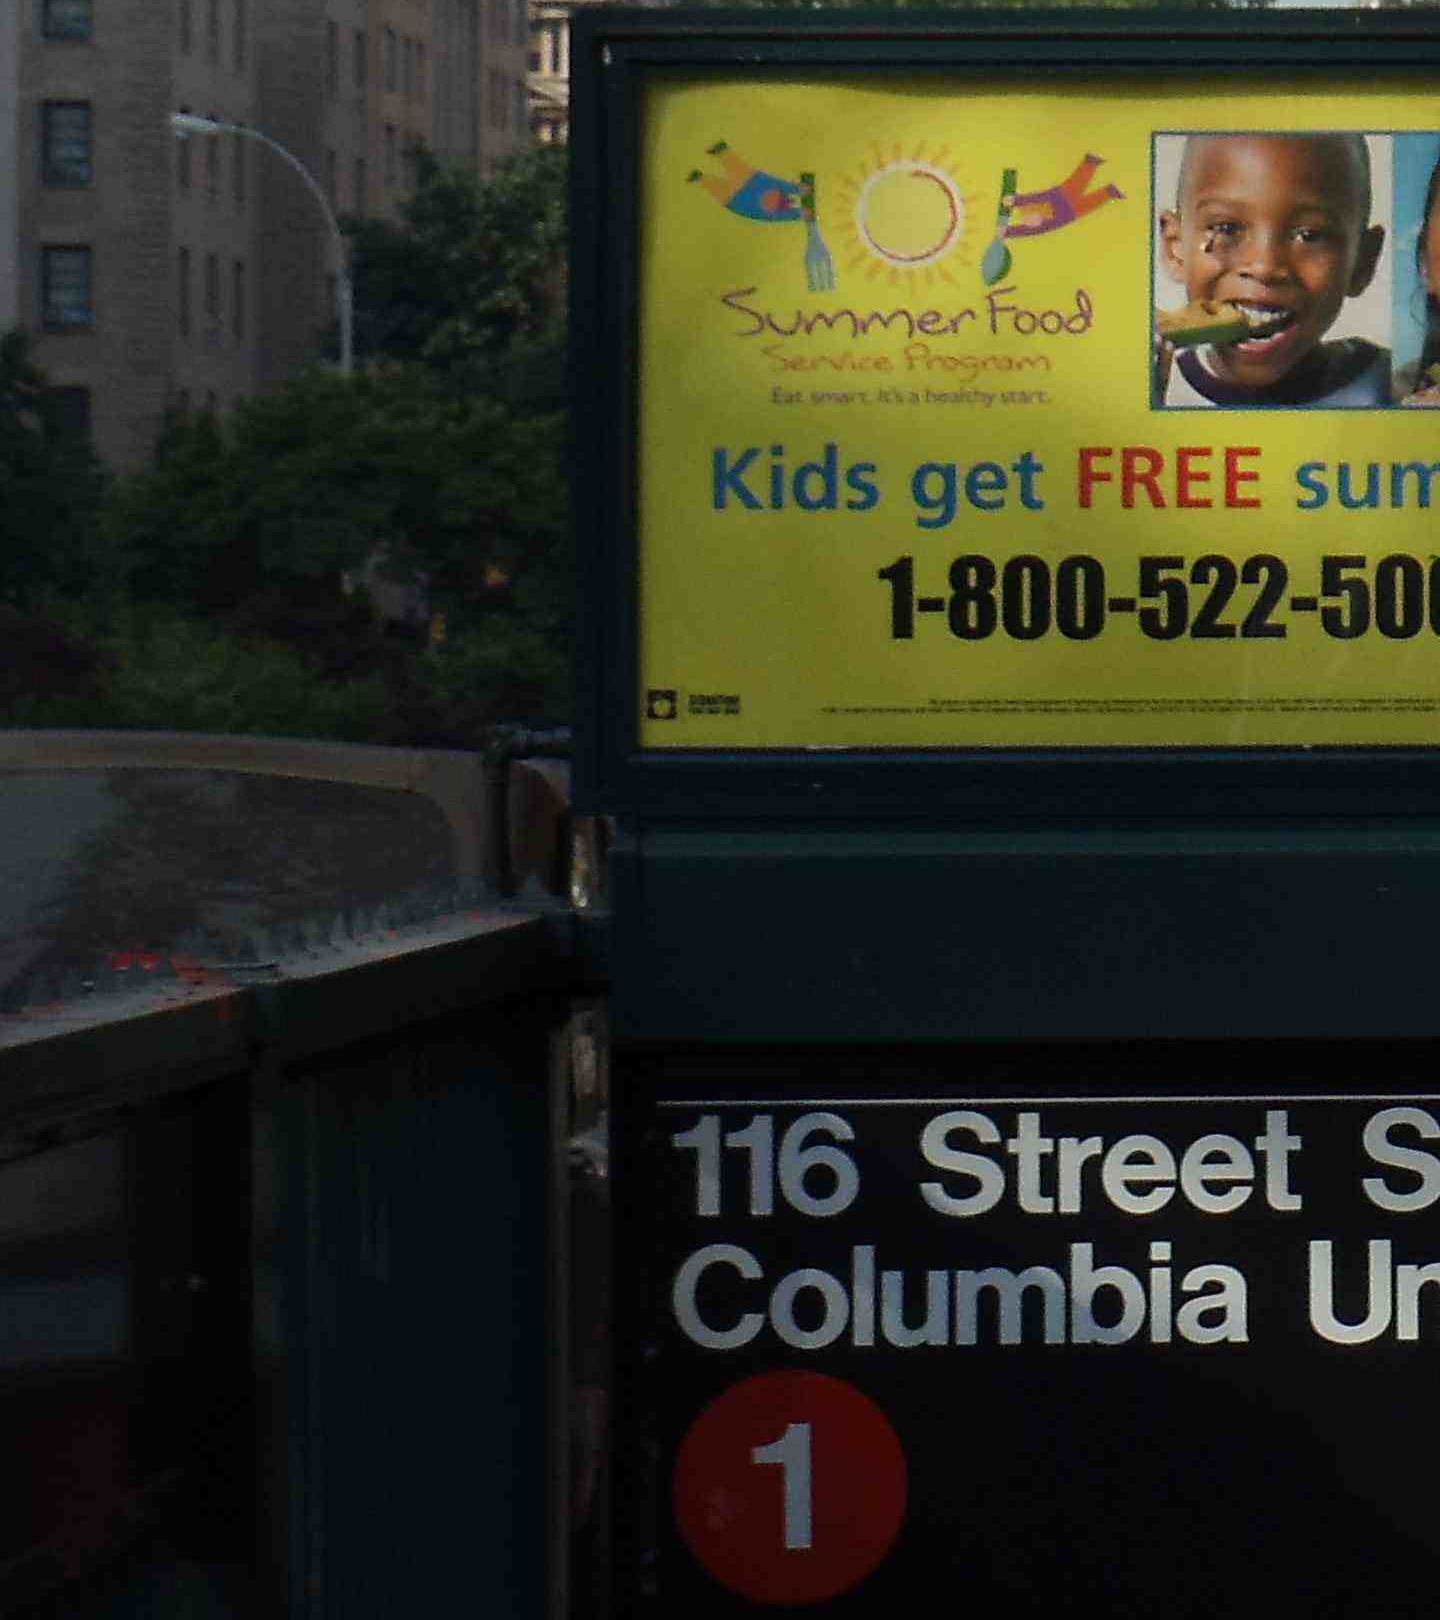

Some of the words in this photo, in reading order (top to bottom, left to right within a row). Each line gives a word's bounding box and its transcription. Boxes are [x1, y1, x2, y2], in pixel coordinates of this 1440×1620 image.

[720, 286, 976, 338] Summer
[986, 285, 1093, 335] Food
[760, 343, 891, 374] Service
[904, 342, 1053, 379] Program
[712, 443, 881, 511] Kids
[910, 451, 1046, 529] get
[1077, 446, 1262, 509] FREE
[673, 1113, 857, 1215] 116
[918, 1109, 1303, 1216] Street
[672, 1243, 1251, 1350] Columbia
[751, 1423, 814, 1550] 1
